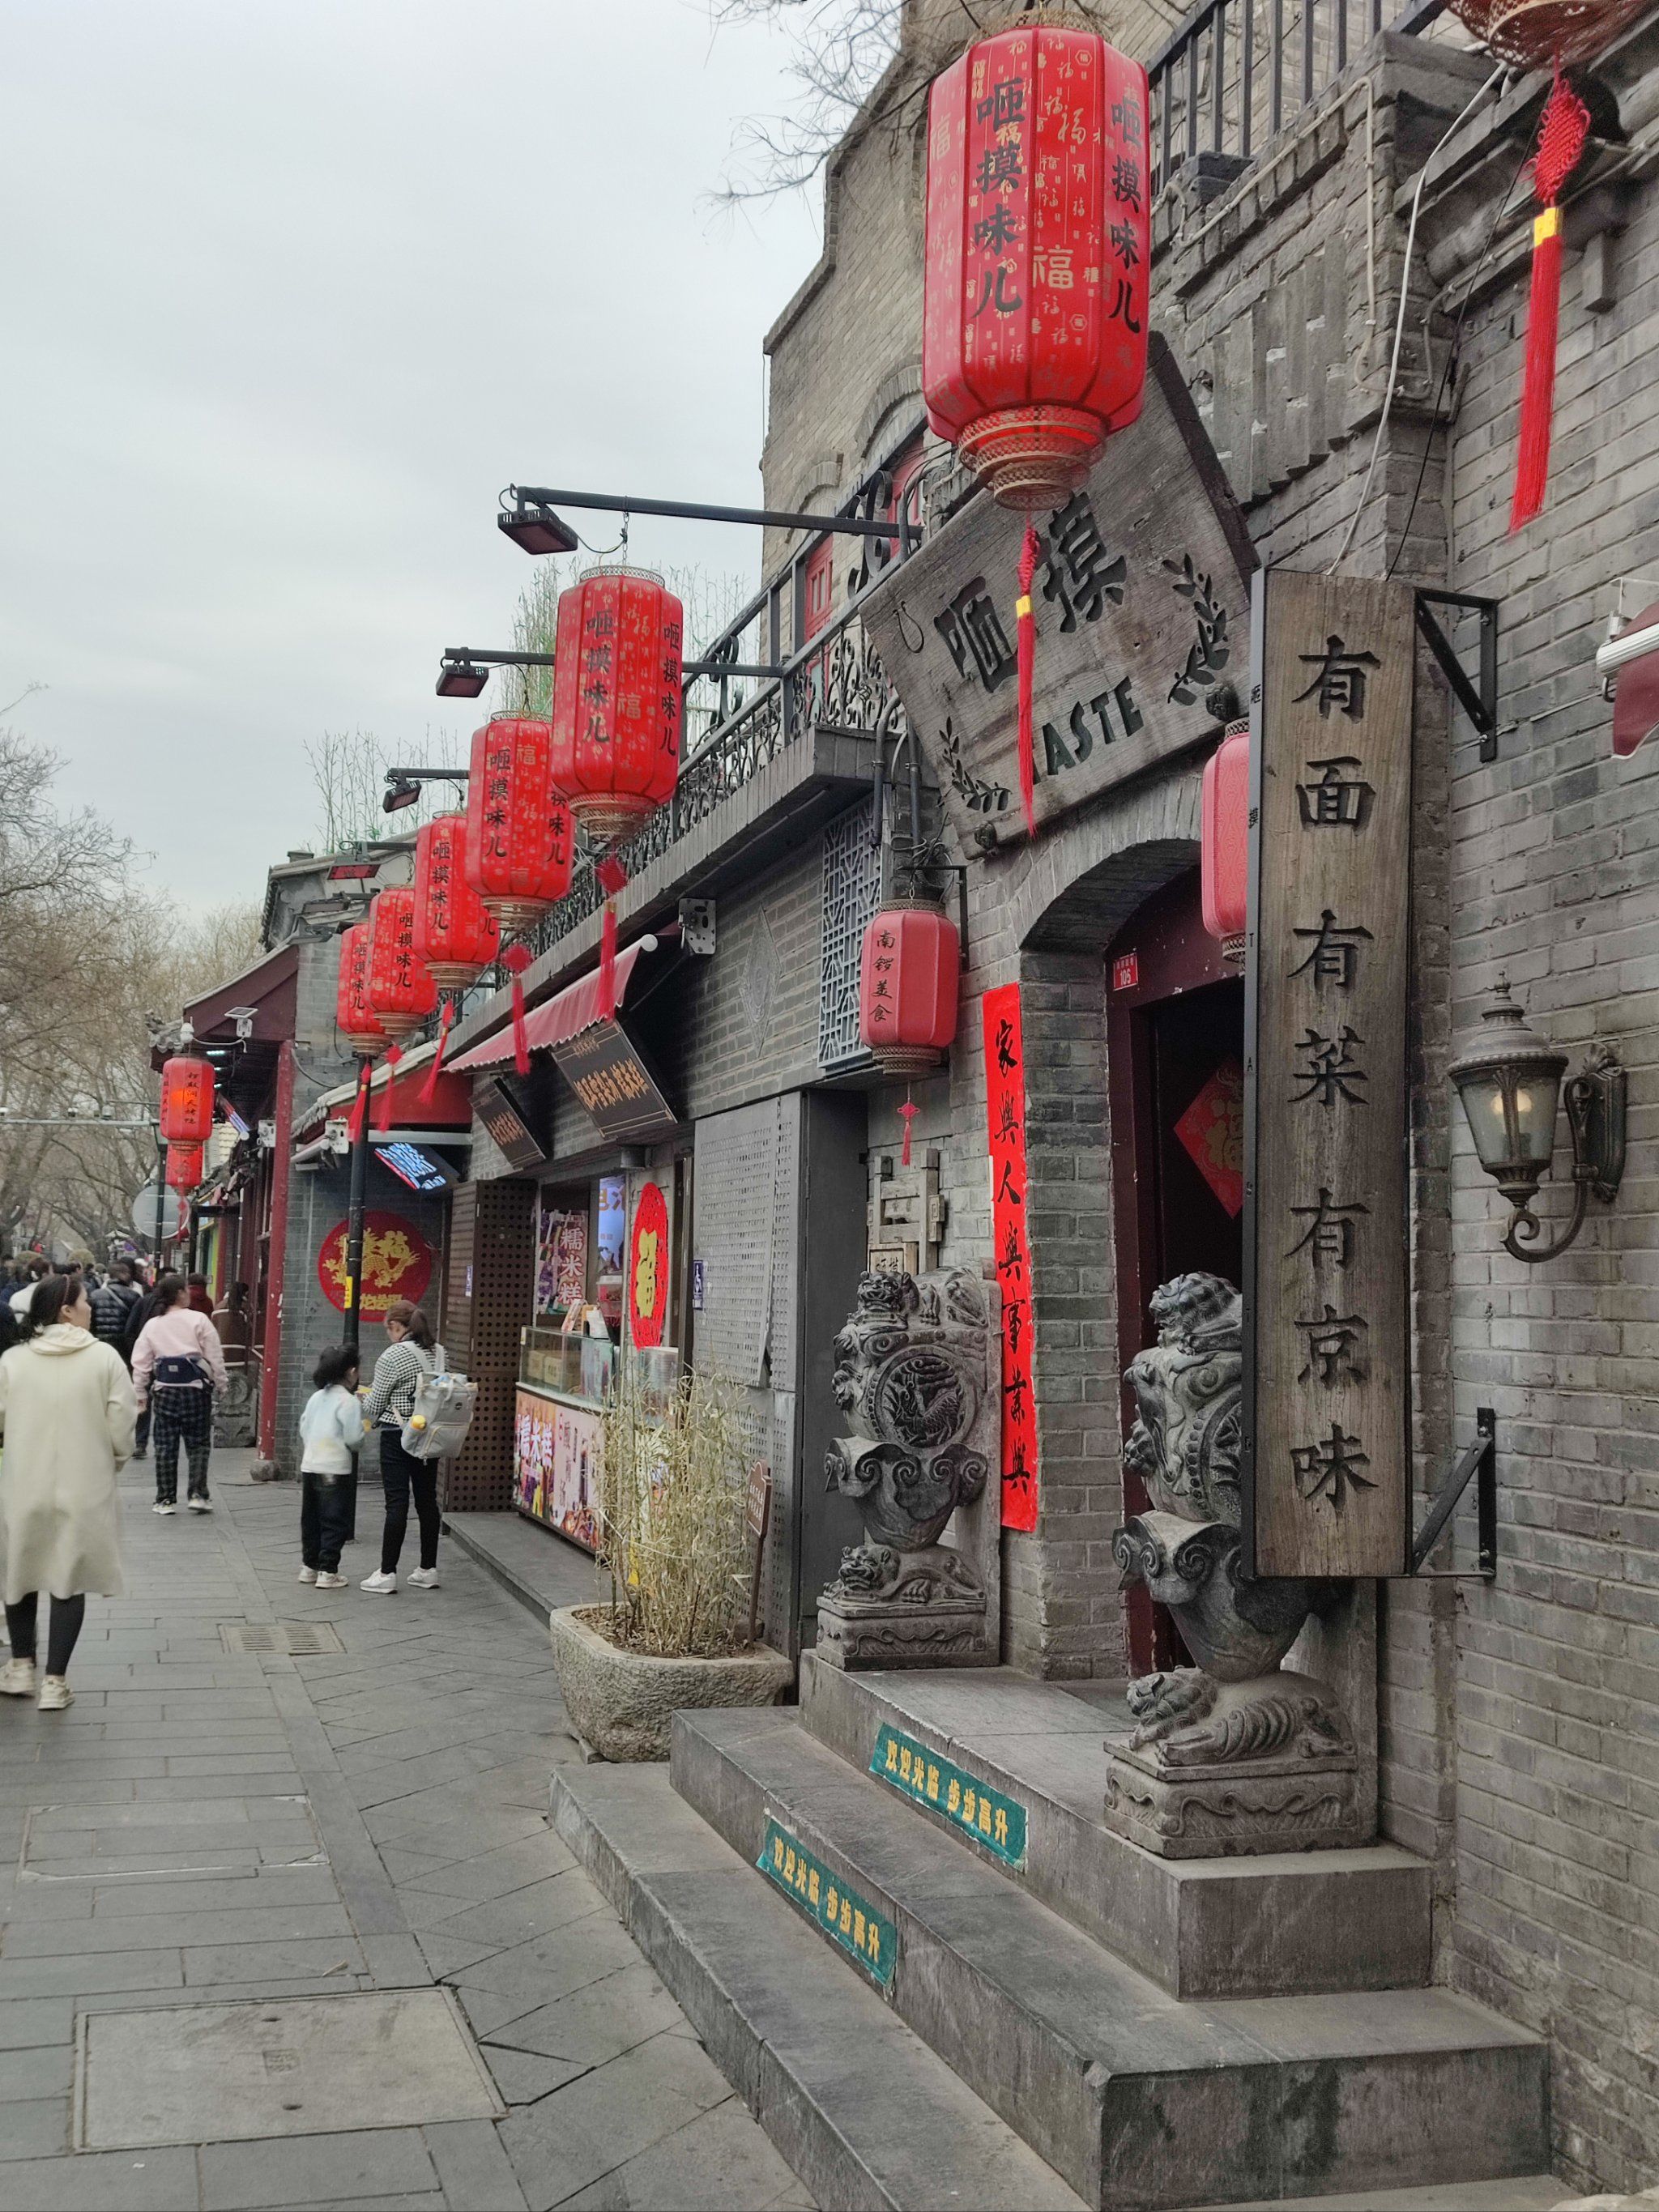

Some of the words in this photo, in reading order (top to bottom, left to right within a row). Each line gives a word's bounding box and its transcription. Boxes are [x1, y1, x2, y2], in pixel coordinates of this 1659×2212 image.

[970, 77, 1024, 319] 咂摸味儿
[1107, 96, 1143, 334] 咂摸味儿
[934, 491, 1128, 693] 咂摸
[582, 609, 615, 744] 咂摸味儿
[659, 622, 680, 757] 咂摸味儿
[1022, 676, 1145, 785] ASTE
[486, 748, 511, 858] 咂摸味儿
[430, 841, 450, 931] 咂摸味儿
[394, 912, 413, 988] 咂摸味儿
[869, 929, 896, 1023] 南锣美食
[885, 1739, 940, 1802] 欢迎光临
[947, 1778, 1009, 1847] 步步高升
[774, 1836, 820, 1905] 欢迎光临
[826, 1886, 881, 1964] 步步高升
